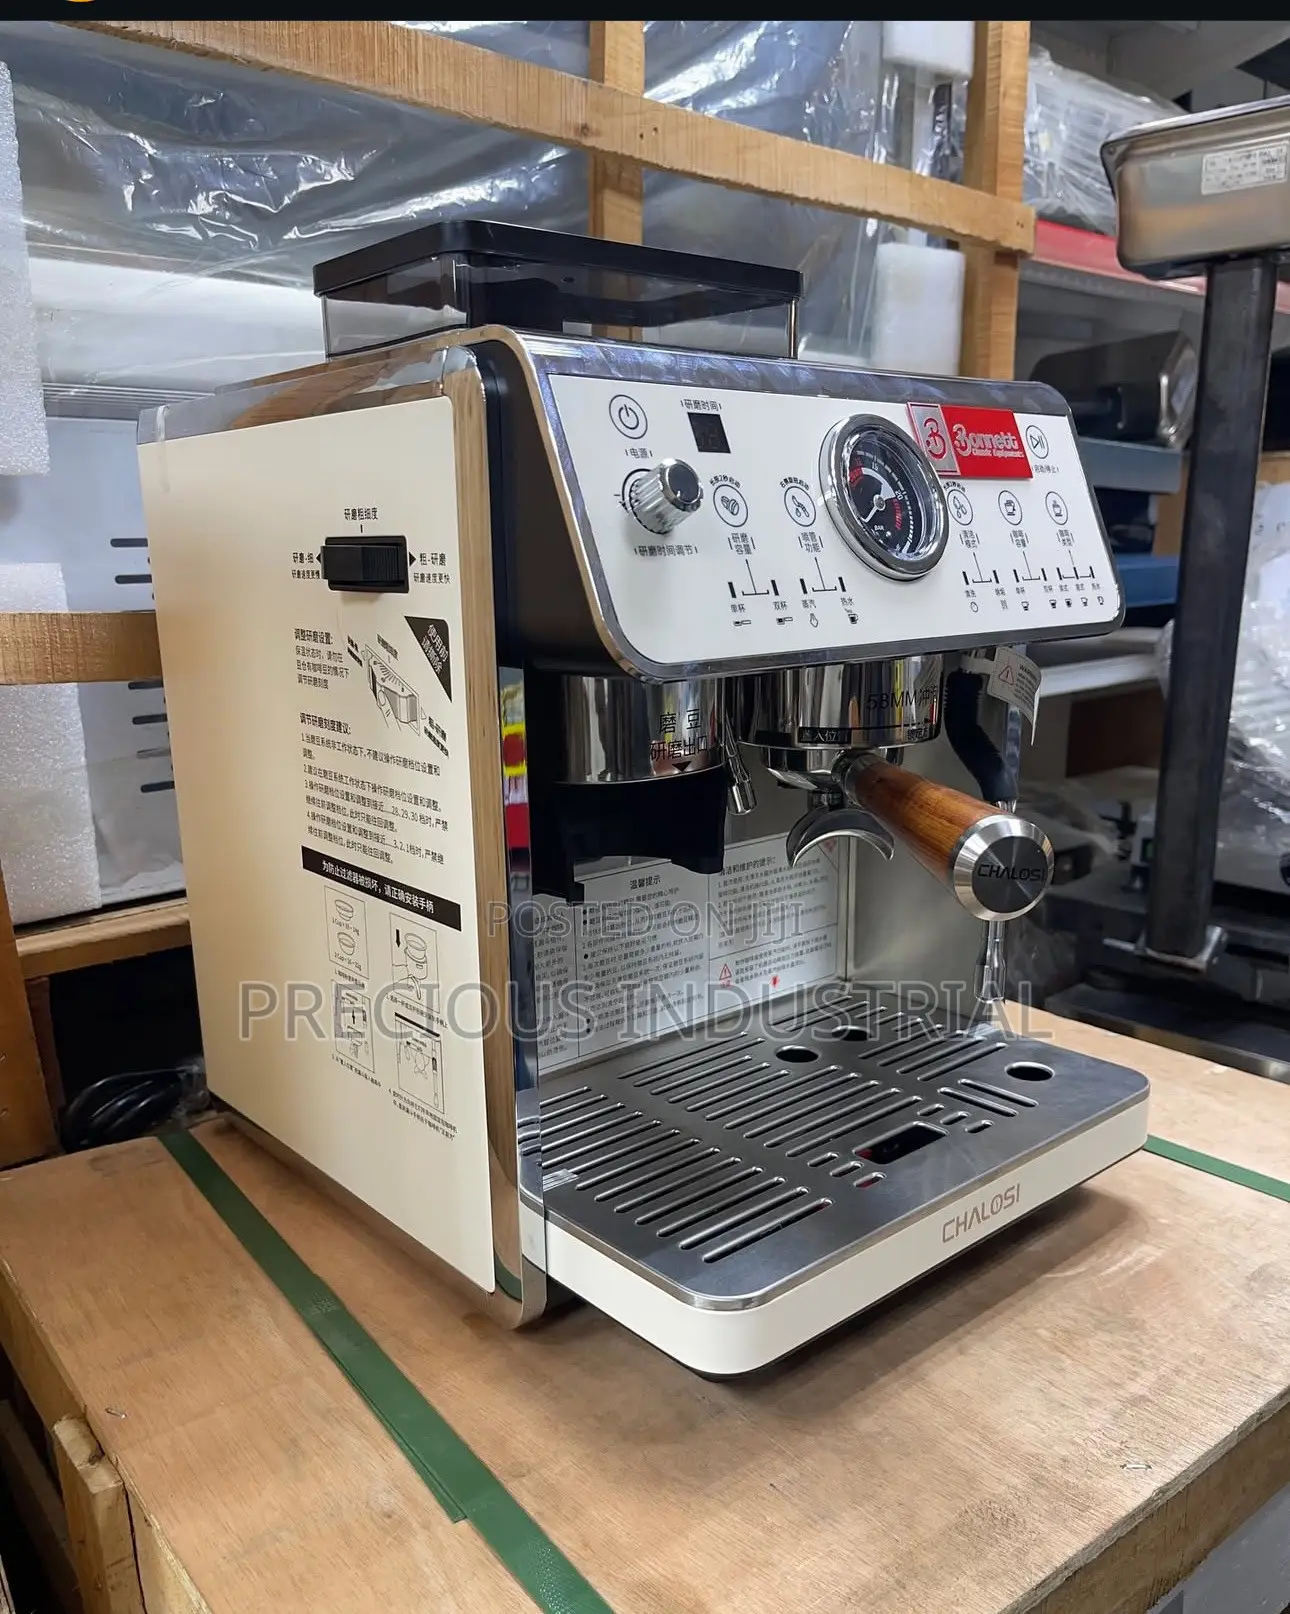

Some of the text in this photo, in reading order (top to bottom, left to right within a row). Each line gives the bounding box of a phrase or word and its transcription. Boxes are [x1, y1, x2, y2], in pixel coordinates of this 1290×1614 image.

[684, 399, 719, 411] 研磨时间
[630, 448, 648, 459] 电源
[344, 508, 378, 520] 研磨粗细度
[731, 533, 749, 543] 研磨
[735, 544, 753, 555] 容量
[773, 601, 788, 611] 双杯
[650, 735, 708, 761] 研磨出口
[978, 864, 1046, 881] CHALOSI
[629, 874, 661, 890] 温馨提示
[942, 1183, 1020, 1243] CHALOSI
